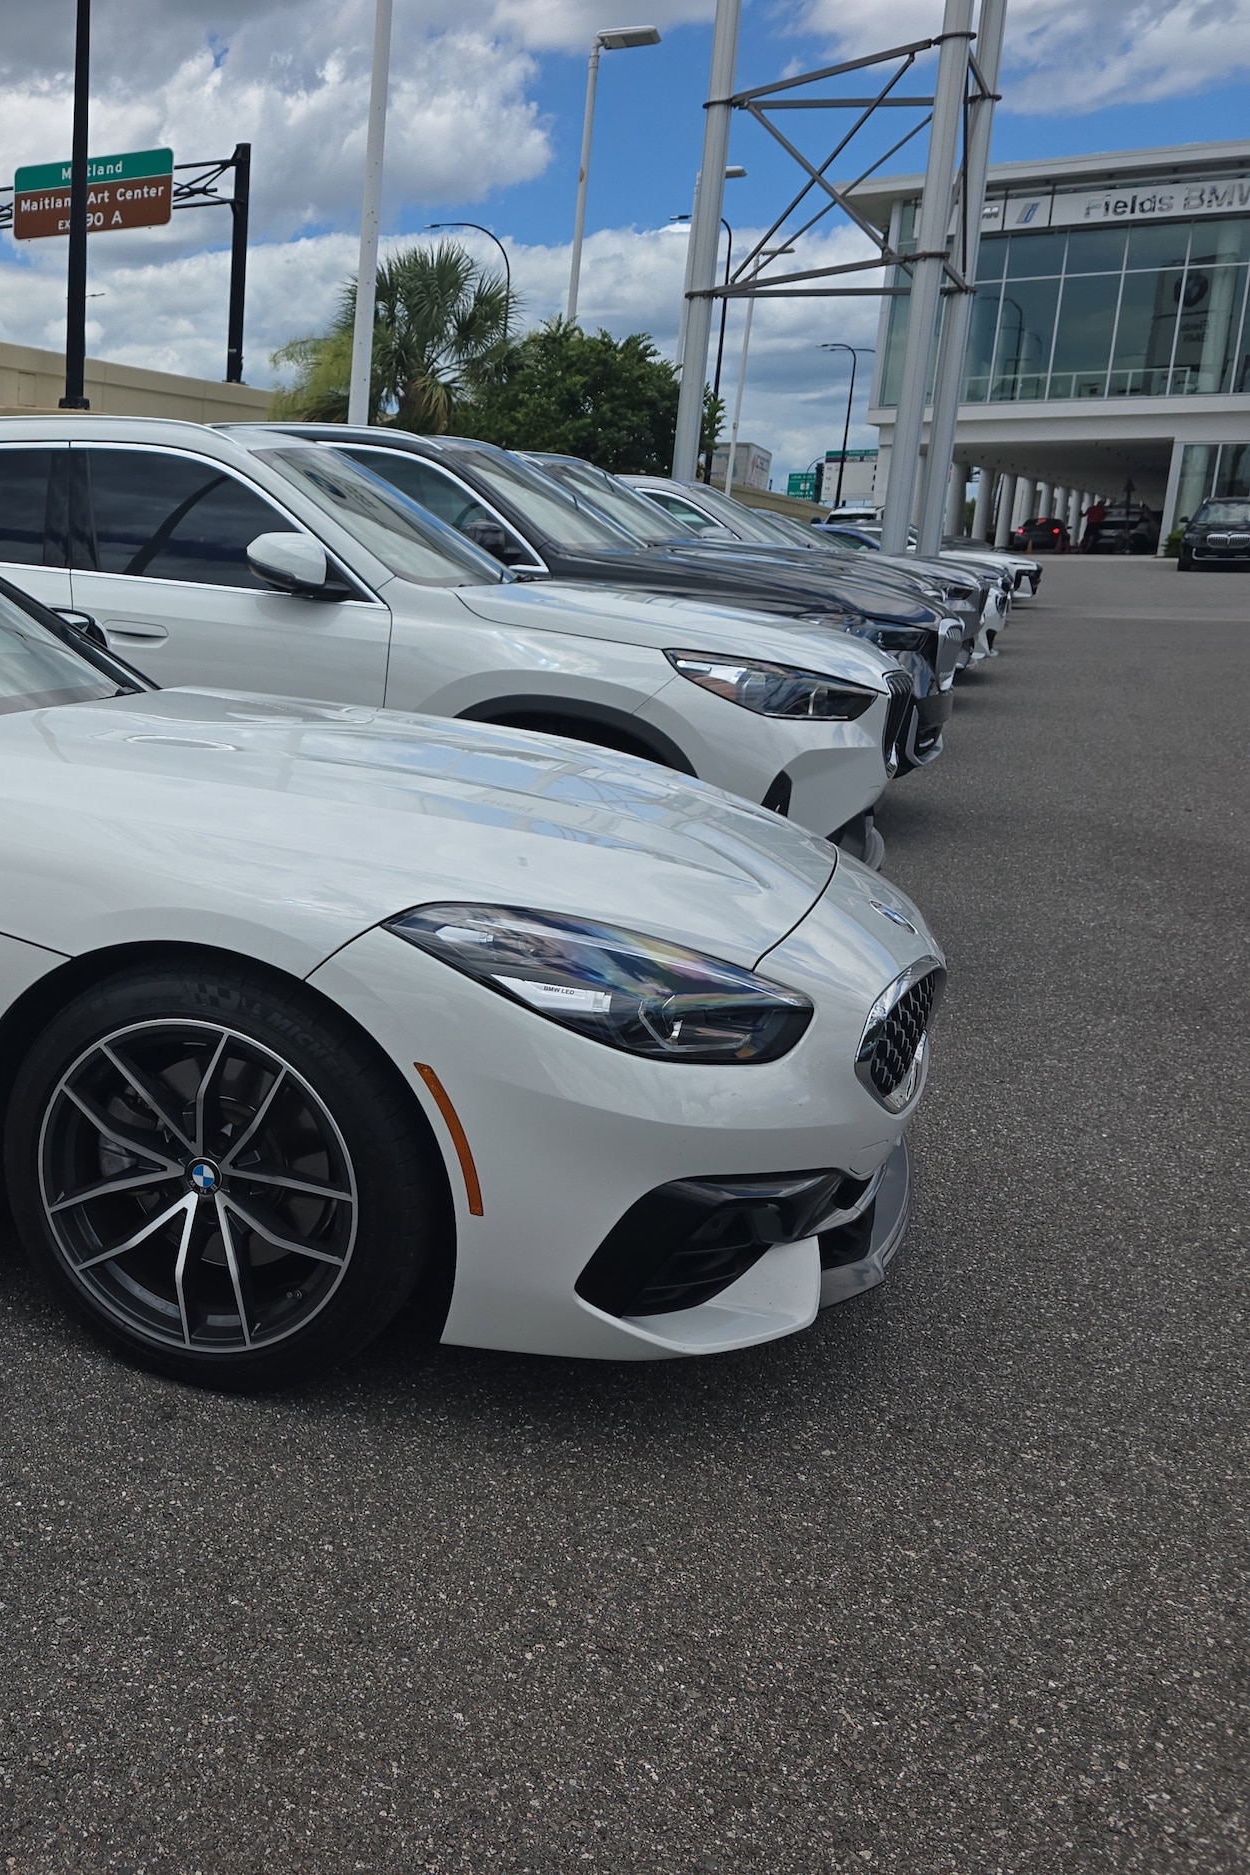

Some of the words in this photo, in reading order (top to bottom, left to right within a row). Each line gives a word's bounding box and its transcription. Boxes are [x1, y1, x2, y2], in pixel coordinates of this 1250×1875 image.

[62, 160, 123, 180] Mtland
[21, 194, 73, 212] Maitlan
[87, 190, 110, 205] Art
[116, 185, 165, 201] Center
[1084, 194, 1174, 218] Fields
[111, 210, 123, 225] A
[266, 1011, 349, 1081] MICHE
